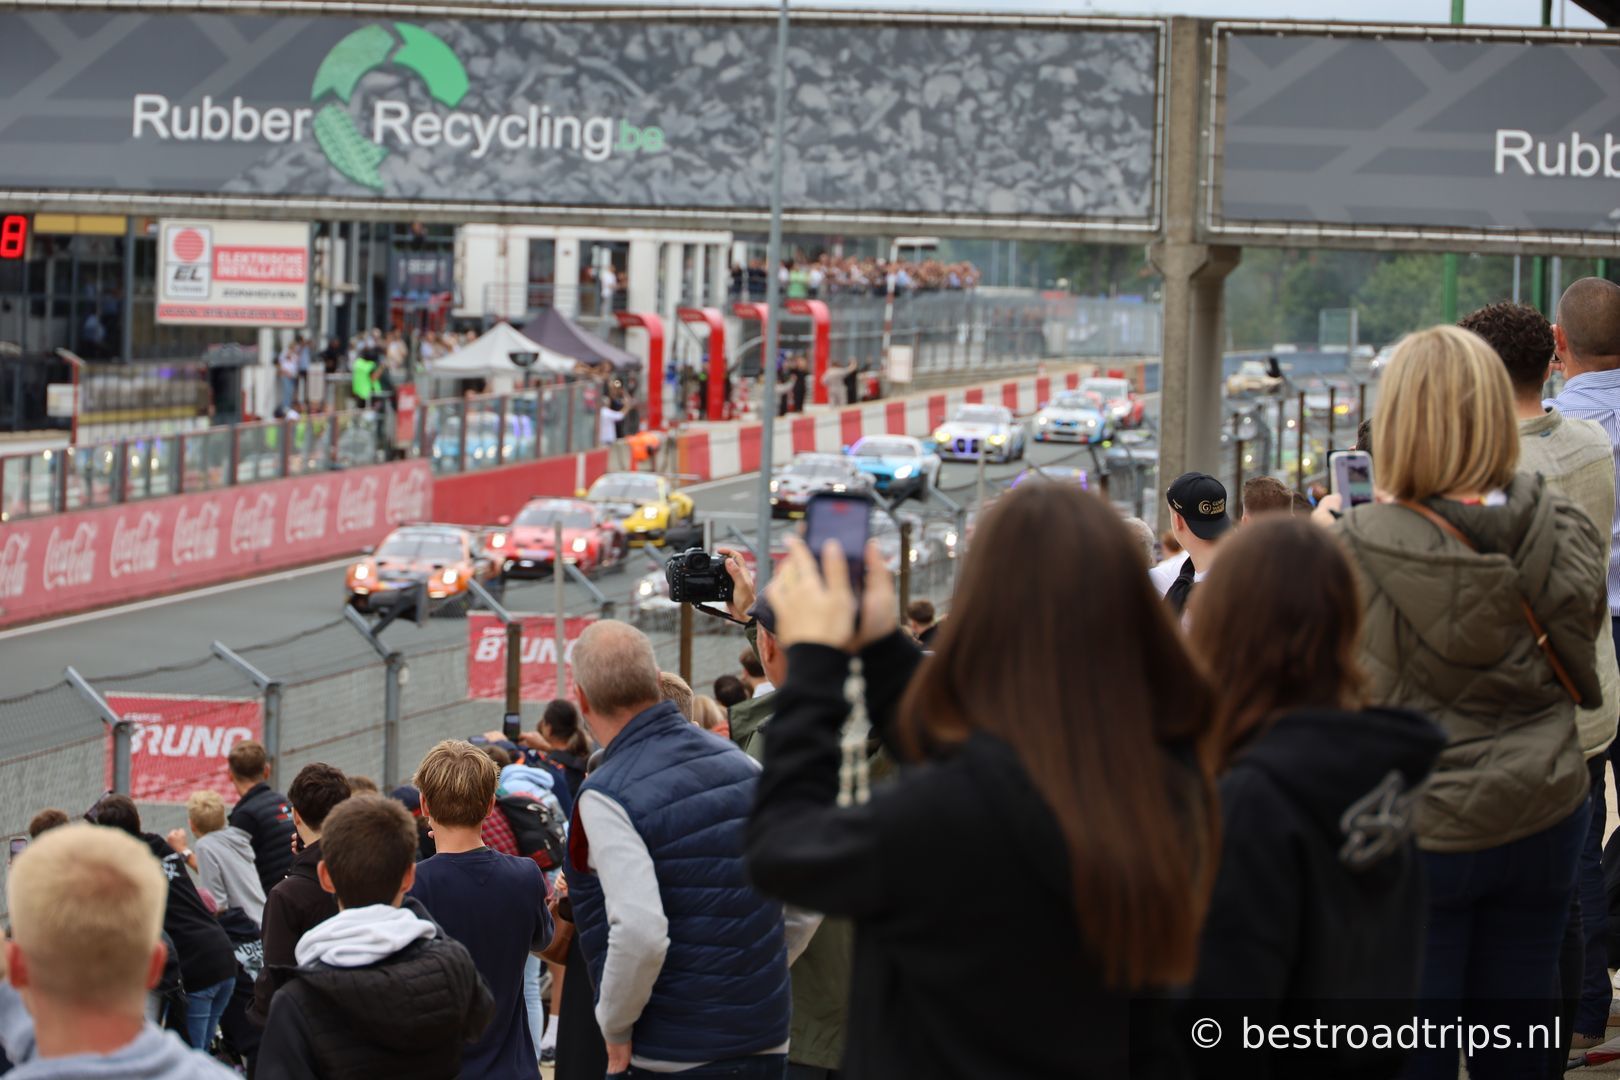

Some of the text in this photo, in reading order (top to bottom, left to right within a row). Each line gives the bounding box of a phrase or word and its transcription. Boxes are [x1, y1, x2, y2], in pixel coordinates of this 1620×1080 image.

[132, 93, 313, 142] Rubber
[1495, 129, 1620, 178] Rubb
[0, 214, 27, 259] 8
[173, 266, 203, 281] EL
[474, 637, 577, 664] BUN
